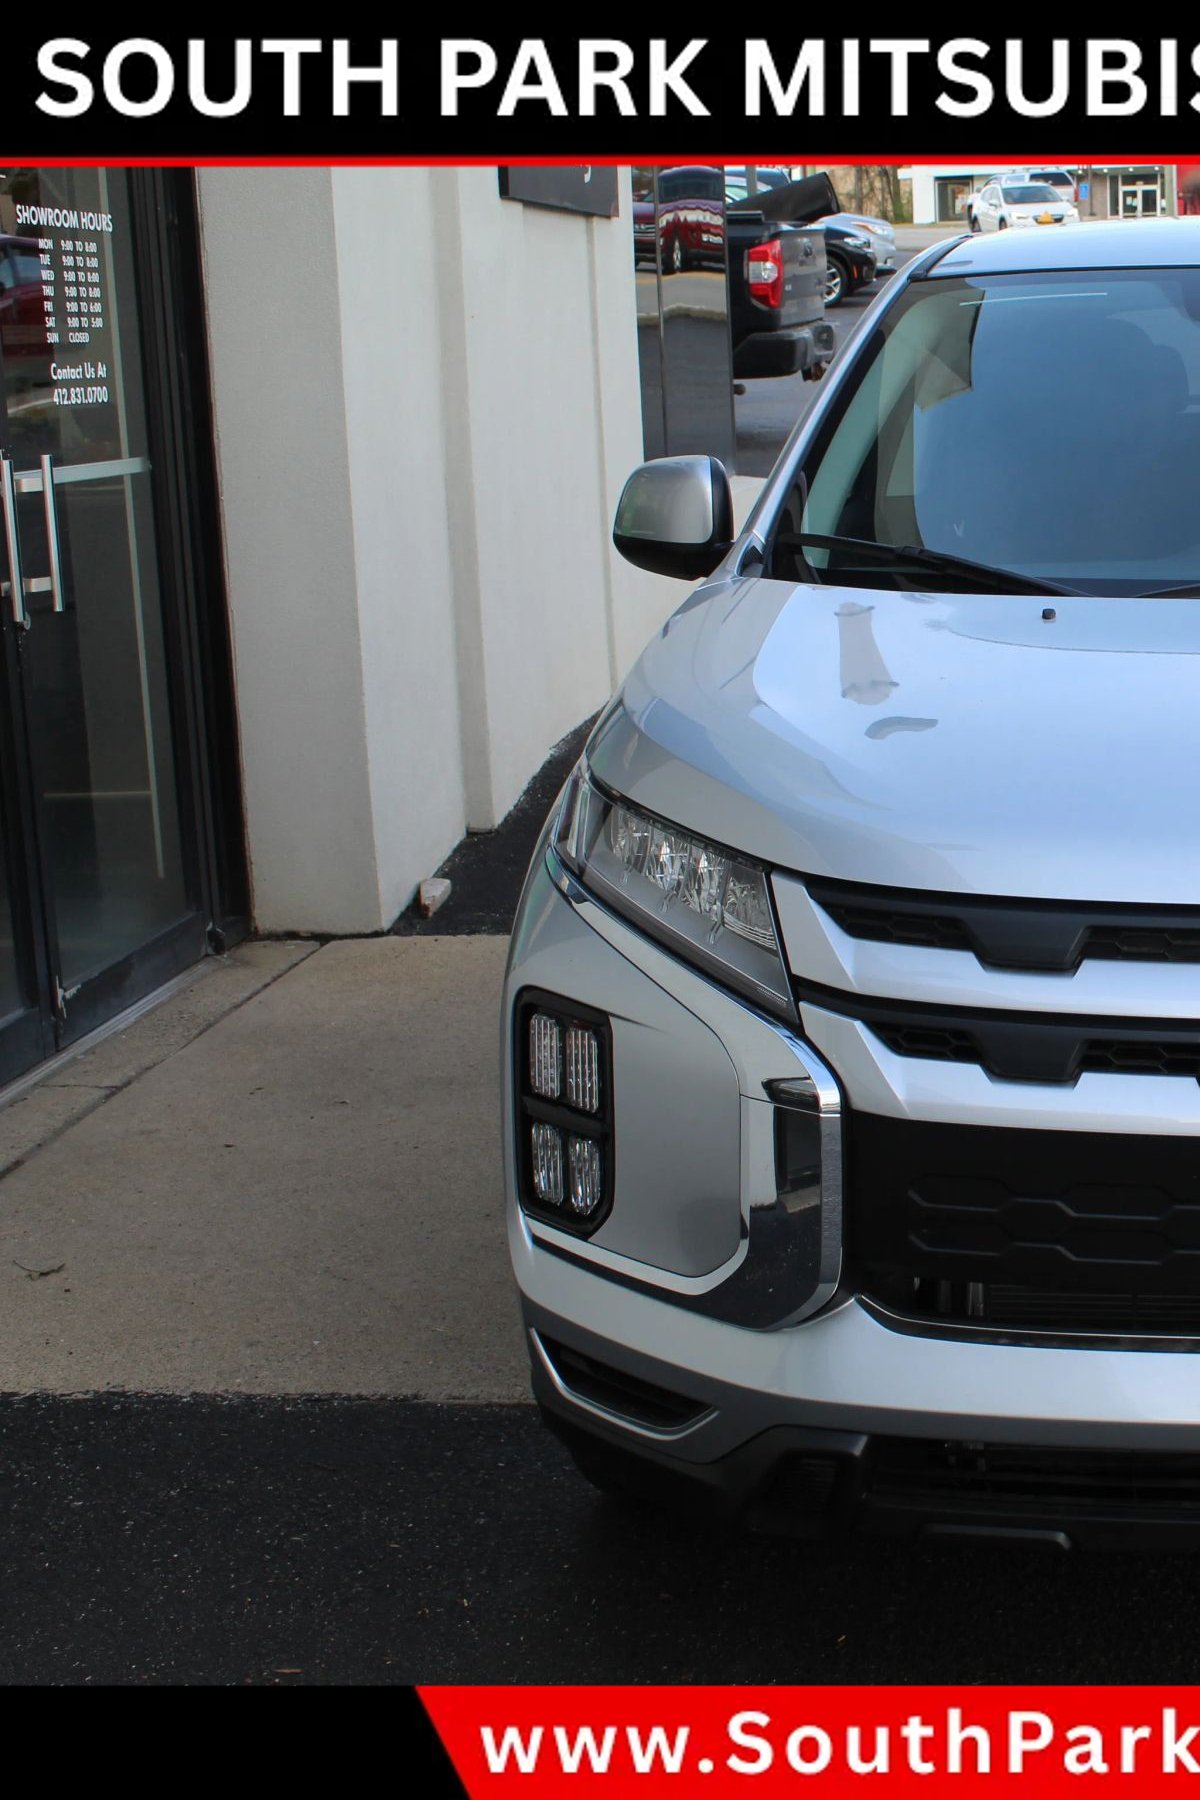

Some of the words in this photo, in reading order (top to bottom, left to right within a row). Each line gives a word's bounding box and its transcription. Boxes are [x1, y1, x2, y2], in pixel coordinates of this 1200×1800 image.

[16, 204, 79, 229] SHOWROOM
[80, 211, 113, 232] HOURS
[38, 238, 54, 250] MON
[61, 239, 74, 252] 9:00
[75, 240, 84, 253] TO
[39, 253, 51, 265] TUE
[62, 255, 75, 267] 9:00
[76, 256, 85, 268] TO
[41, 269, 55, 281] WED
[63, 271, 76, 282] 9:00
[77, 271, 86, 283] TO
[42, 285, 55, 297] THU
[64, 286, 77, 298] 9:00
[78, 286, 88, 298] TO
[43, 301, 54, 312] FRI
[66, 301, 79, 313] 9:00
[80, 301, 88, 313] TO
[45, 316, 56, 328] SAT
[67, 316, 80, 328] 9:00
[80, 317, 89, 328] TO
[46, 332, 59, 343] SUN
[68, 331, 90, 344] CLOSED
[50, 362, 83, 381] Contact
[84, 361, 96, 379] Us
[97, 361, 107, 379] At
[53, 385, 109, 406] 412.831.0700
